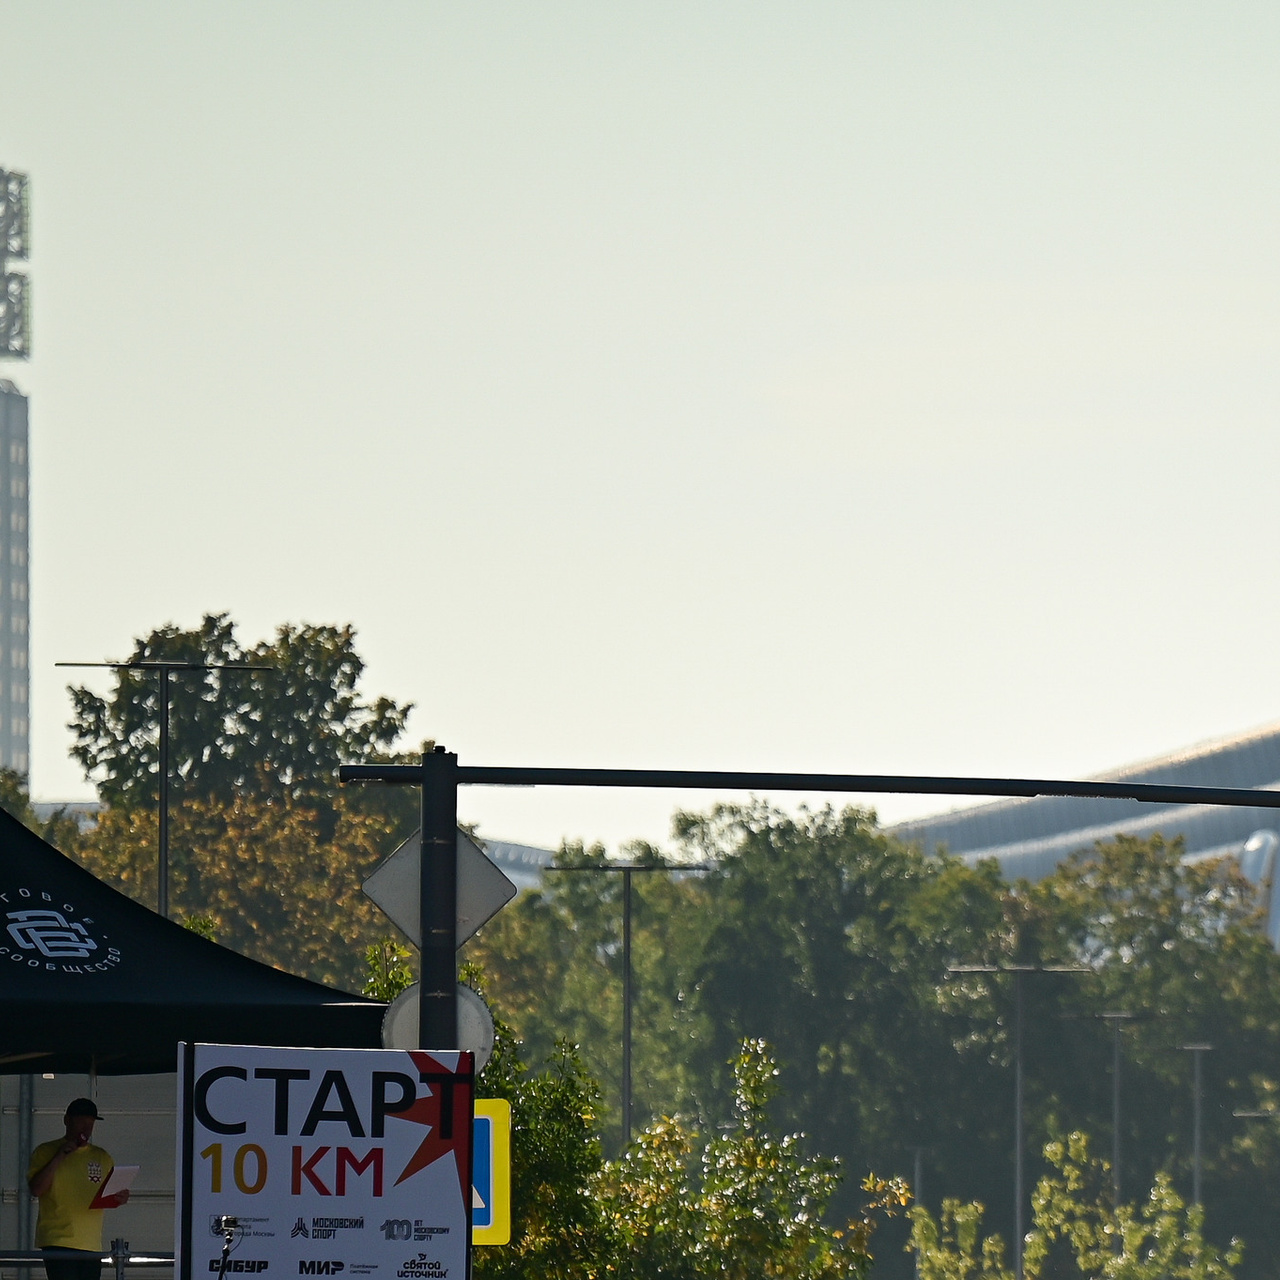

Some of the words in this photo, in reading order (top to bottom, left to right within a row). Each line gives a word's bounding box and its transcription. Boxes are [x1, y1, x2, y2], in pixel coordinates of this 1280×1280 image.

[194, 1065, 473, 1140] СТАРТ
[200, 1143, 268, 1195] 10
[291, 1145, 384, 1198] КМ
[312, 1216, 365, 1229] МОСКОВСКИЙ
[312, 1229, 337, 1240] СПОРТ
[209, 1259, 269, 1273] СИБУР
[299, 1260, 345, 1275] МИР
